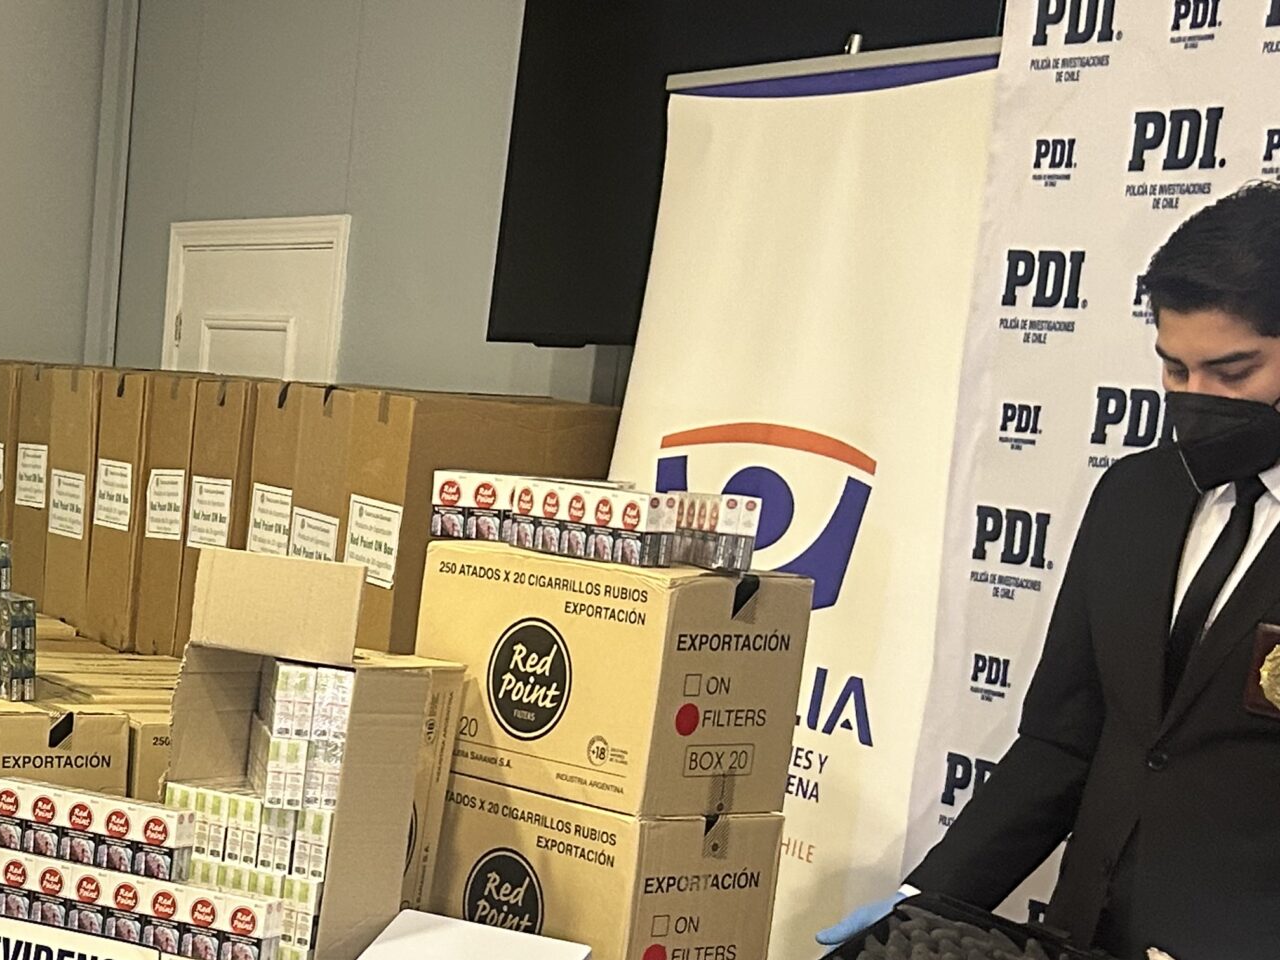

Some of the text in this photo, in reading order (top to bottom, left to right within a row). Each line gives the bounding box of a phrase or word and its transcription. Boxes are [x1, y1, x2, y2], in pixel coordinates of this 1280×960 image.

[1090, 387, 1167, 447] PD
[439, 561, 648, 603] 250 ATADOS X 20 CIGARRILLOS RUBIOS
[564, 598, 646, 626] EXPORTACIÓN
[676, 631, 791, 652] EXPORTACIÓN
[510, 642, 556, 677] Red
[498, 671, 561, 709] Point
[706, 676, 730, 695] ON
[702, 709, 766, 728] FILTERS
[2, 752, 112, 769] EXPORTACIÓN
[688, 750, 748, 771] BOX 20
[818, 753, 828, 774] Y
[446, 790, 616, 846] TADOS X 20 CIGARRILLOS RUBIOS
[536, 836, 615, 867] EXPORTACIÓN
[484, 871, 524, 907] Red
[643, 868, 760, 894] EXPORTACIÓN
[474, 898, 533, 933] Point
[674, 916, 700, 934] ON
